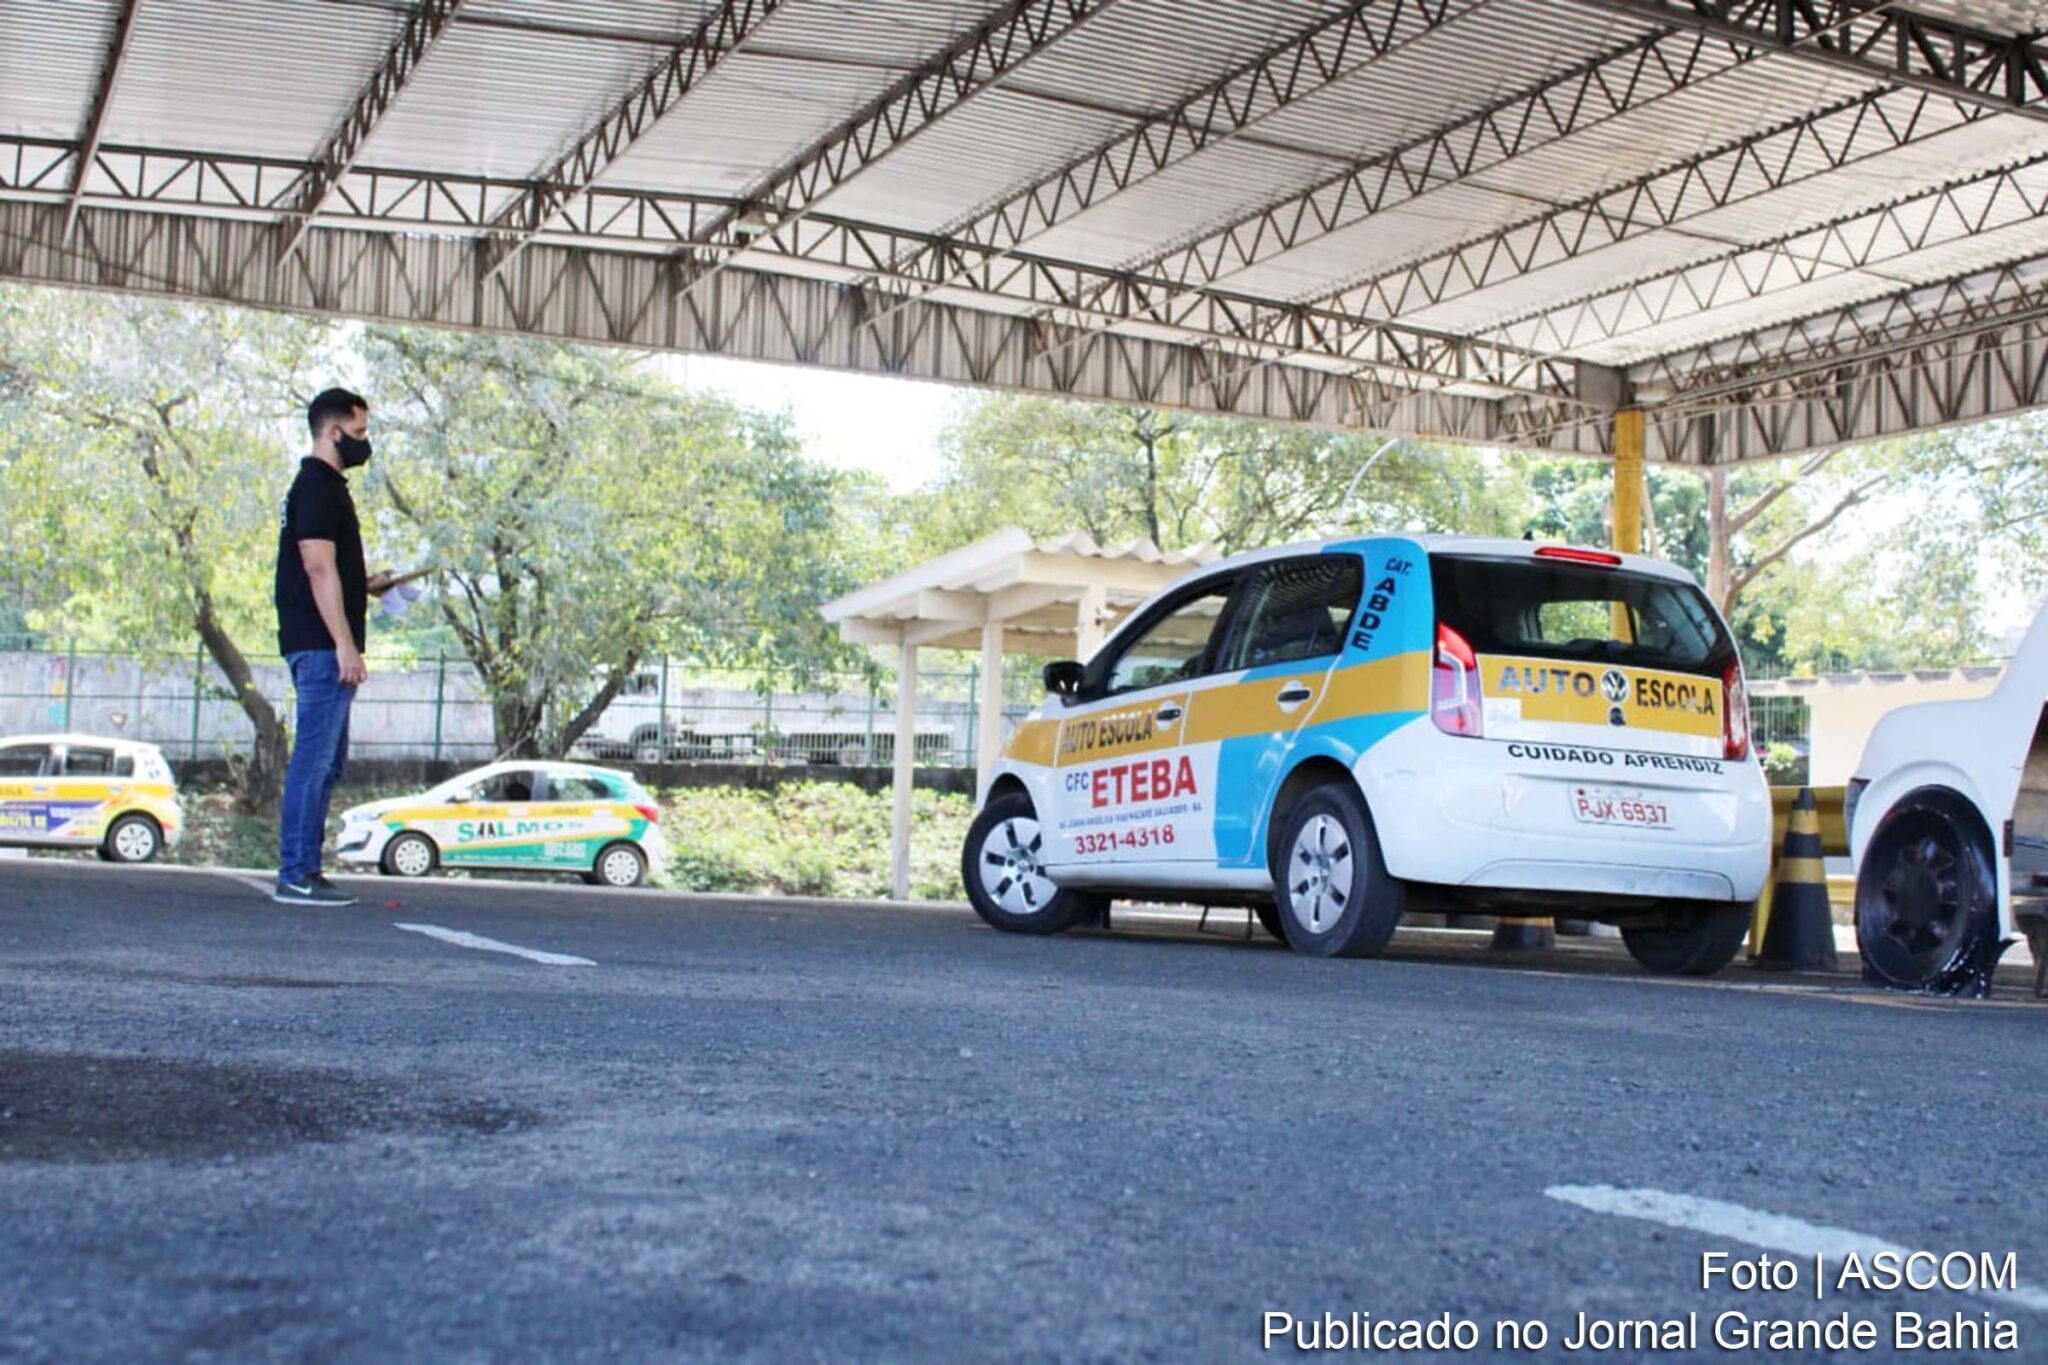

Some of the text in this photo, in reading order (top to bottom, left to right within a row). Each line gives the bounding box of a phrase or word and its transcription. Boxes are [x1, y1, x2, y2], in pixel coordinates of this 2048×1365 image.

[1498, 666, 1594, 695] AUTO
[1635, 677, 1715, 715] ESCOLA
[1062, 710, 1152, 752] AUTO ESCOLA
[1507, 743, 1725, 775] CUIDADO APRENDIZ
[1065, 755, 1196, 808] CFC ETEBA
[1577, 798, 1668, 824] PJX 6937
[1075, 823, 1175, 854] 3321-4318
